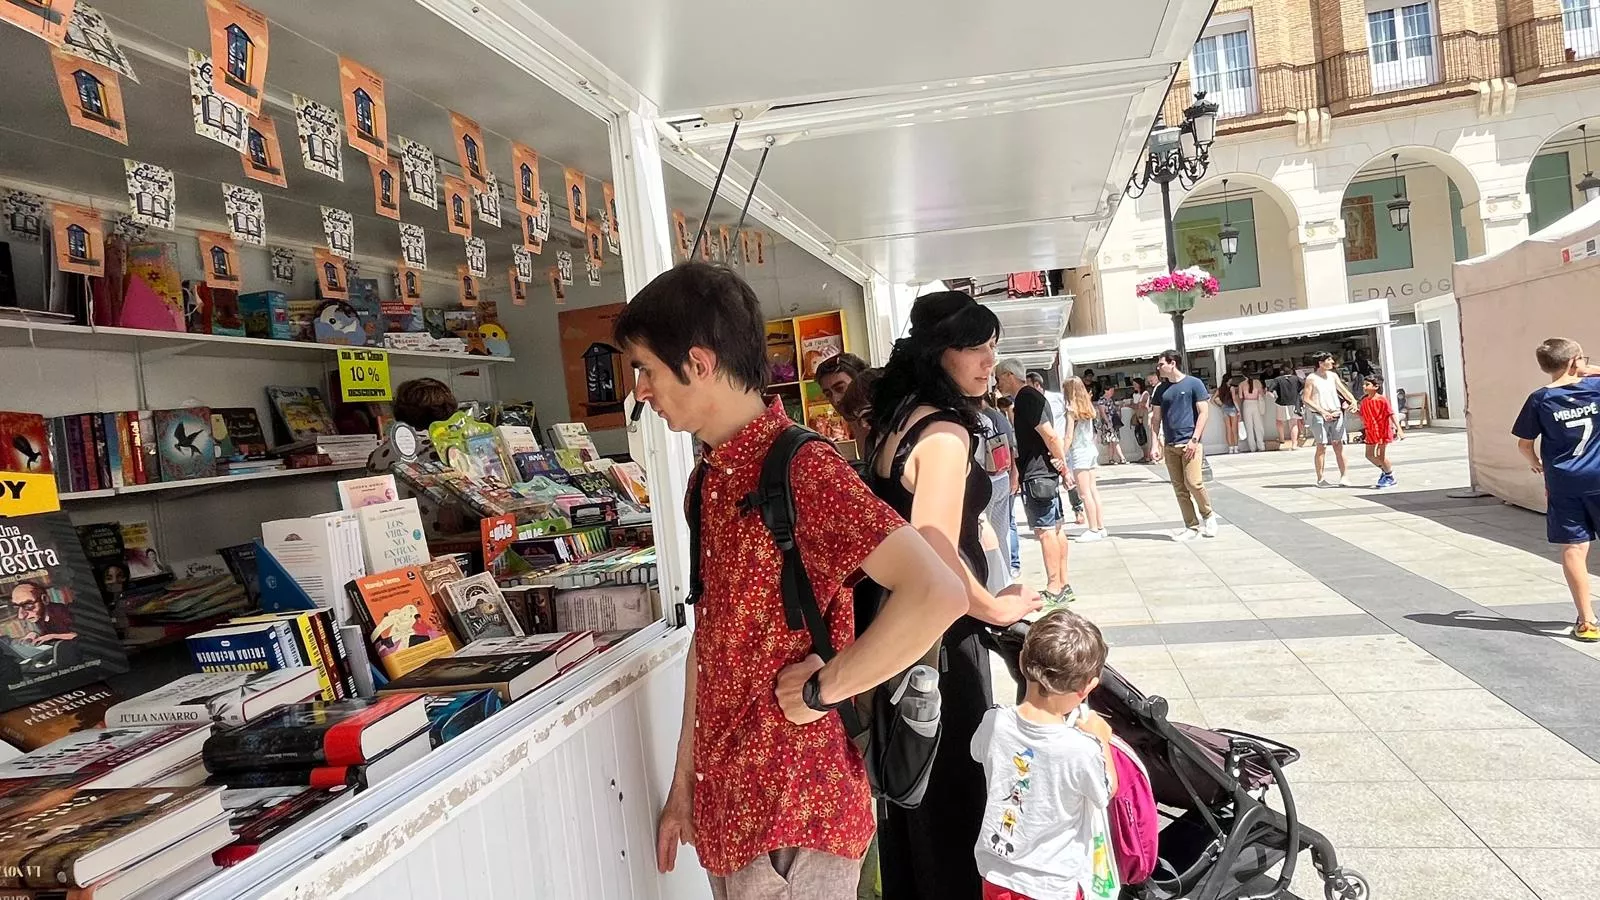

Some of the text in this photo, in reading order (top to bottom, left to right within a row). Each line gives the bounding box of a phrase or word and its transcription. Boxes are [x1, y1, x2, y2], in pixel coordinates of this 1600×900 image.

[350, 366, 380, 382] 10 %
[347, 388, 386, 397] DESCUENTO
[1553, 402, 1598, 421] MBAPPÉ
[1565, 418, 1593, 456] 7
[0, 481, 27, 499] Y
[0, 548, 60, 575] estra
[236, 646, 266, 661] FREIDA
[29, 690, 86, 714] ARTURO
[120, 711, 198, 723] JULIA NAVARRO
